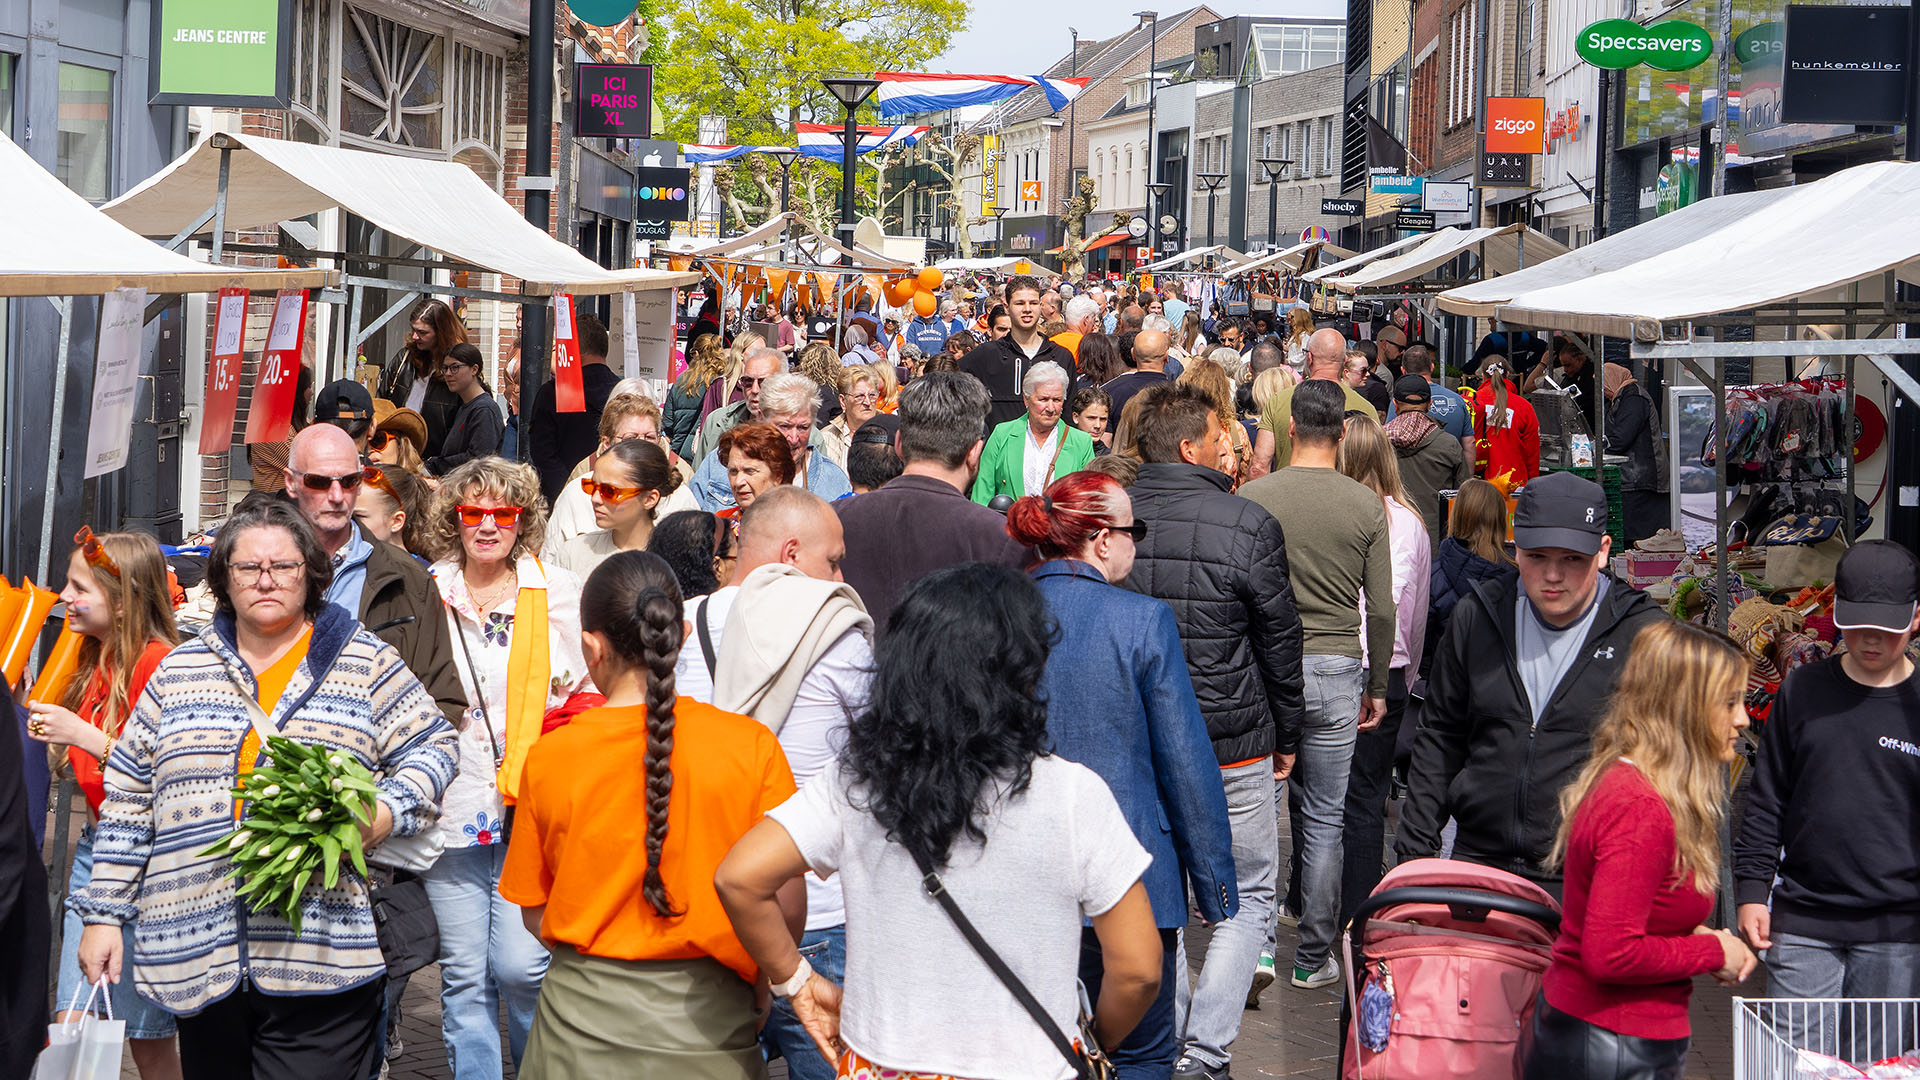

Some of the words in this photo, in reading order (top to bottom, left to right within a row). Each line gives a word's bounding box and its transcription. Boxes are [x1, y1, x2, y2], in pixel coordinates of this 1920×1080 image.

[173, 28, 215, 43] JEANS
[217, 29, 267, 45] CENTRE
[1588, 32, 1702, 53] Specsavers
[1791, 59, 1902, 70] hunkemöller
[603, 76, 626, 91] ICI
[591, 94, 638, 109] PARIS
[603, 111, 625, 126] XL
[1494, 116, 1536, 135] ziggo
[1322, 201, 1358, 213] shoeby
[213, 359, 235, 391] 15.-
[261, 354, 290, 385] 20.-
